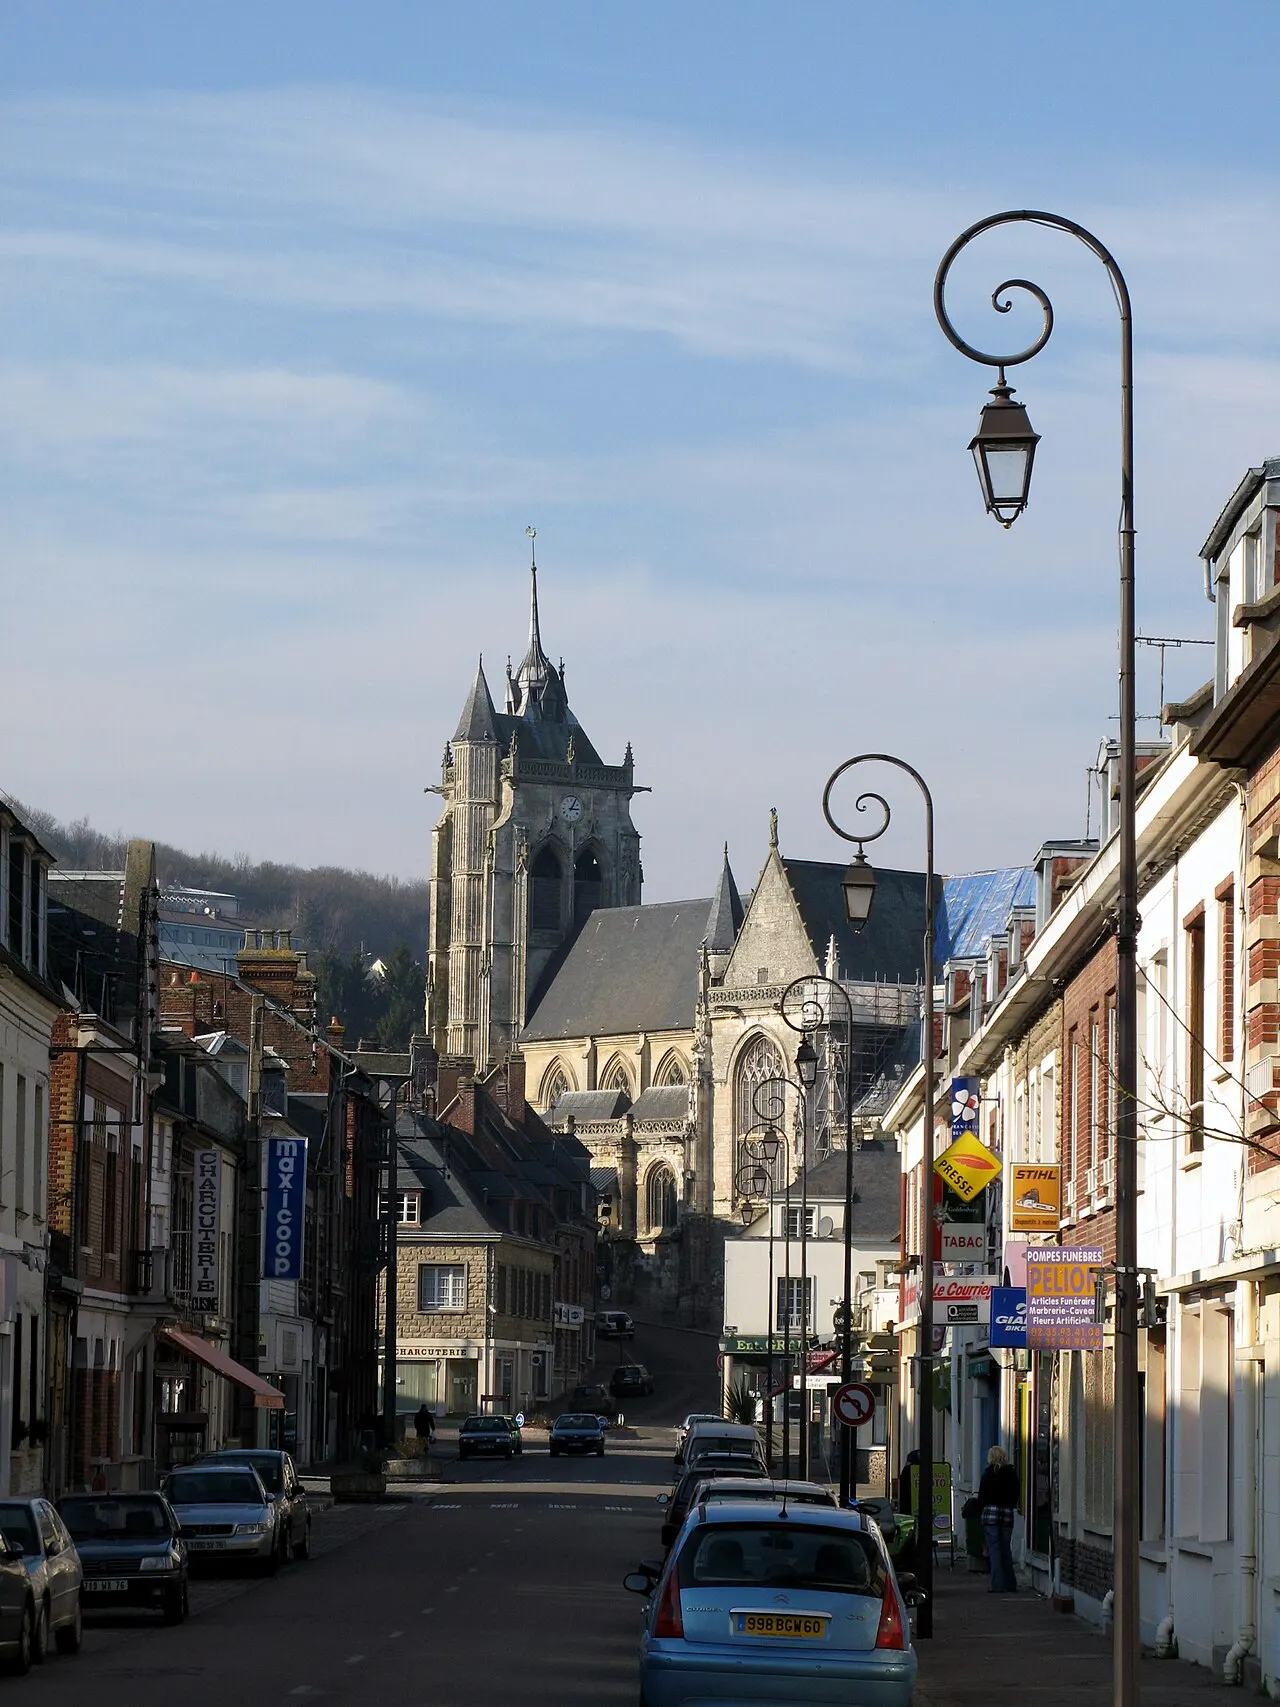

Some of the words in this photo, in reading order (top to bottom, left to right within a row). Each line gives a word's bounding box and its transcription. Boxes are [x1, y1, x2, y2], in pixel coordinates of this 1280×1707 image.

[938, 1160, 974, 1196] PRESSE
[1016, 1170, 1057, 1180] STIHL
[275, 1140, 297, 1276] maxicoop
[197, 1152, 216, 1292] CHARCUTERIE
[943, 1236, 983, 1248] TABAC
[1027, 1251, 1060, 1262] POMPES
[1062, 1247, 1102, 1262] FUNÈBRES
[933, 1283, 945, 1296] Le
[1060, 1297, 1095, 1305] Funéraire
[1033, 1317, 1055, 1325] Fleurs
[736, 1340, 763, 1350] Ent.
[747, 1617, 774, 1631] 998
[776, 1619, 802, 1633] BGW
[804, 1620, 820, 1633] 60
